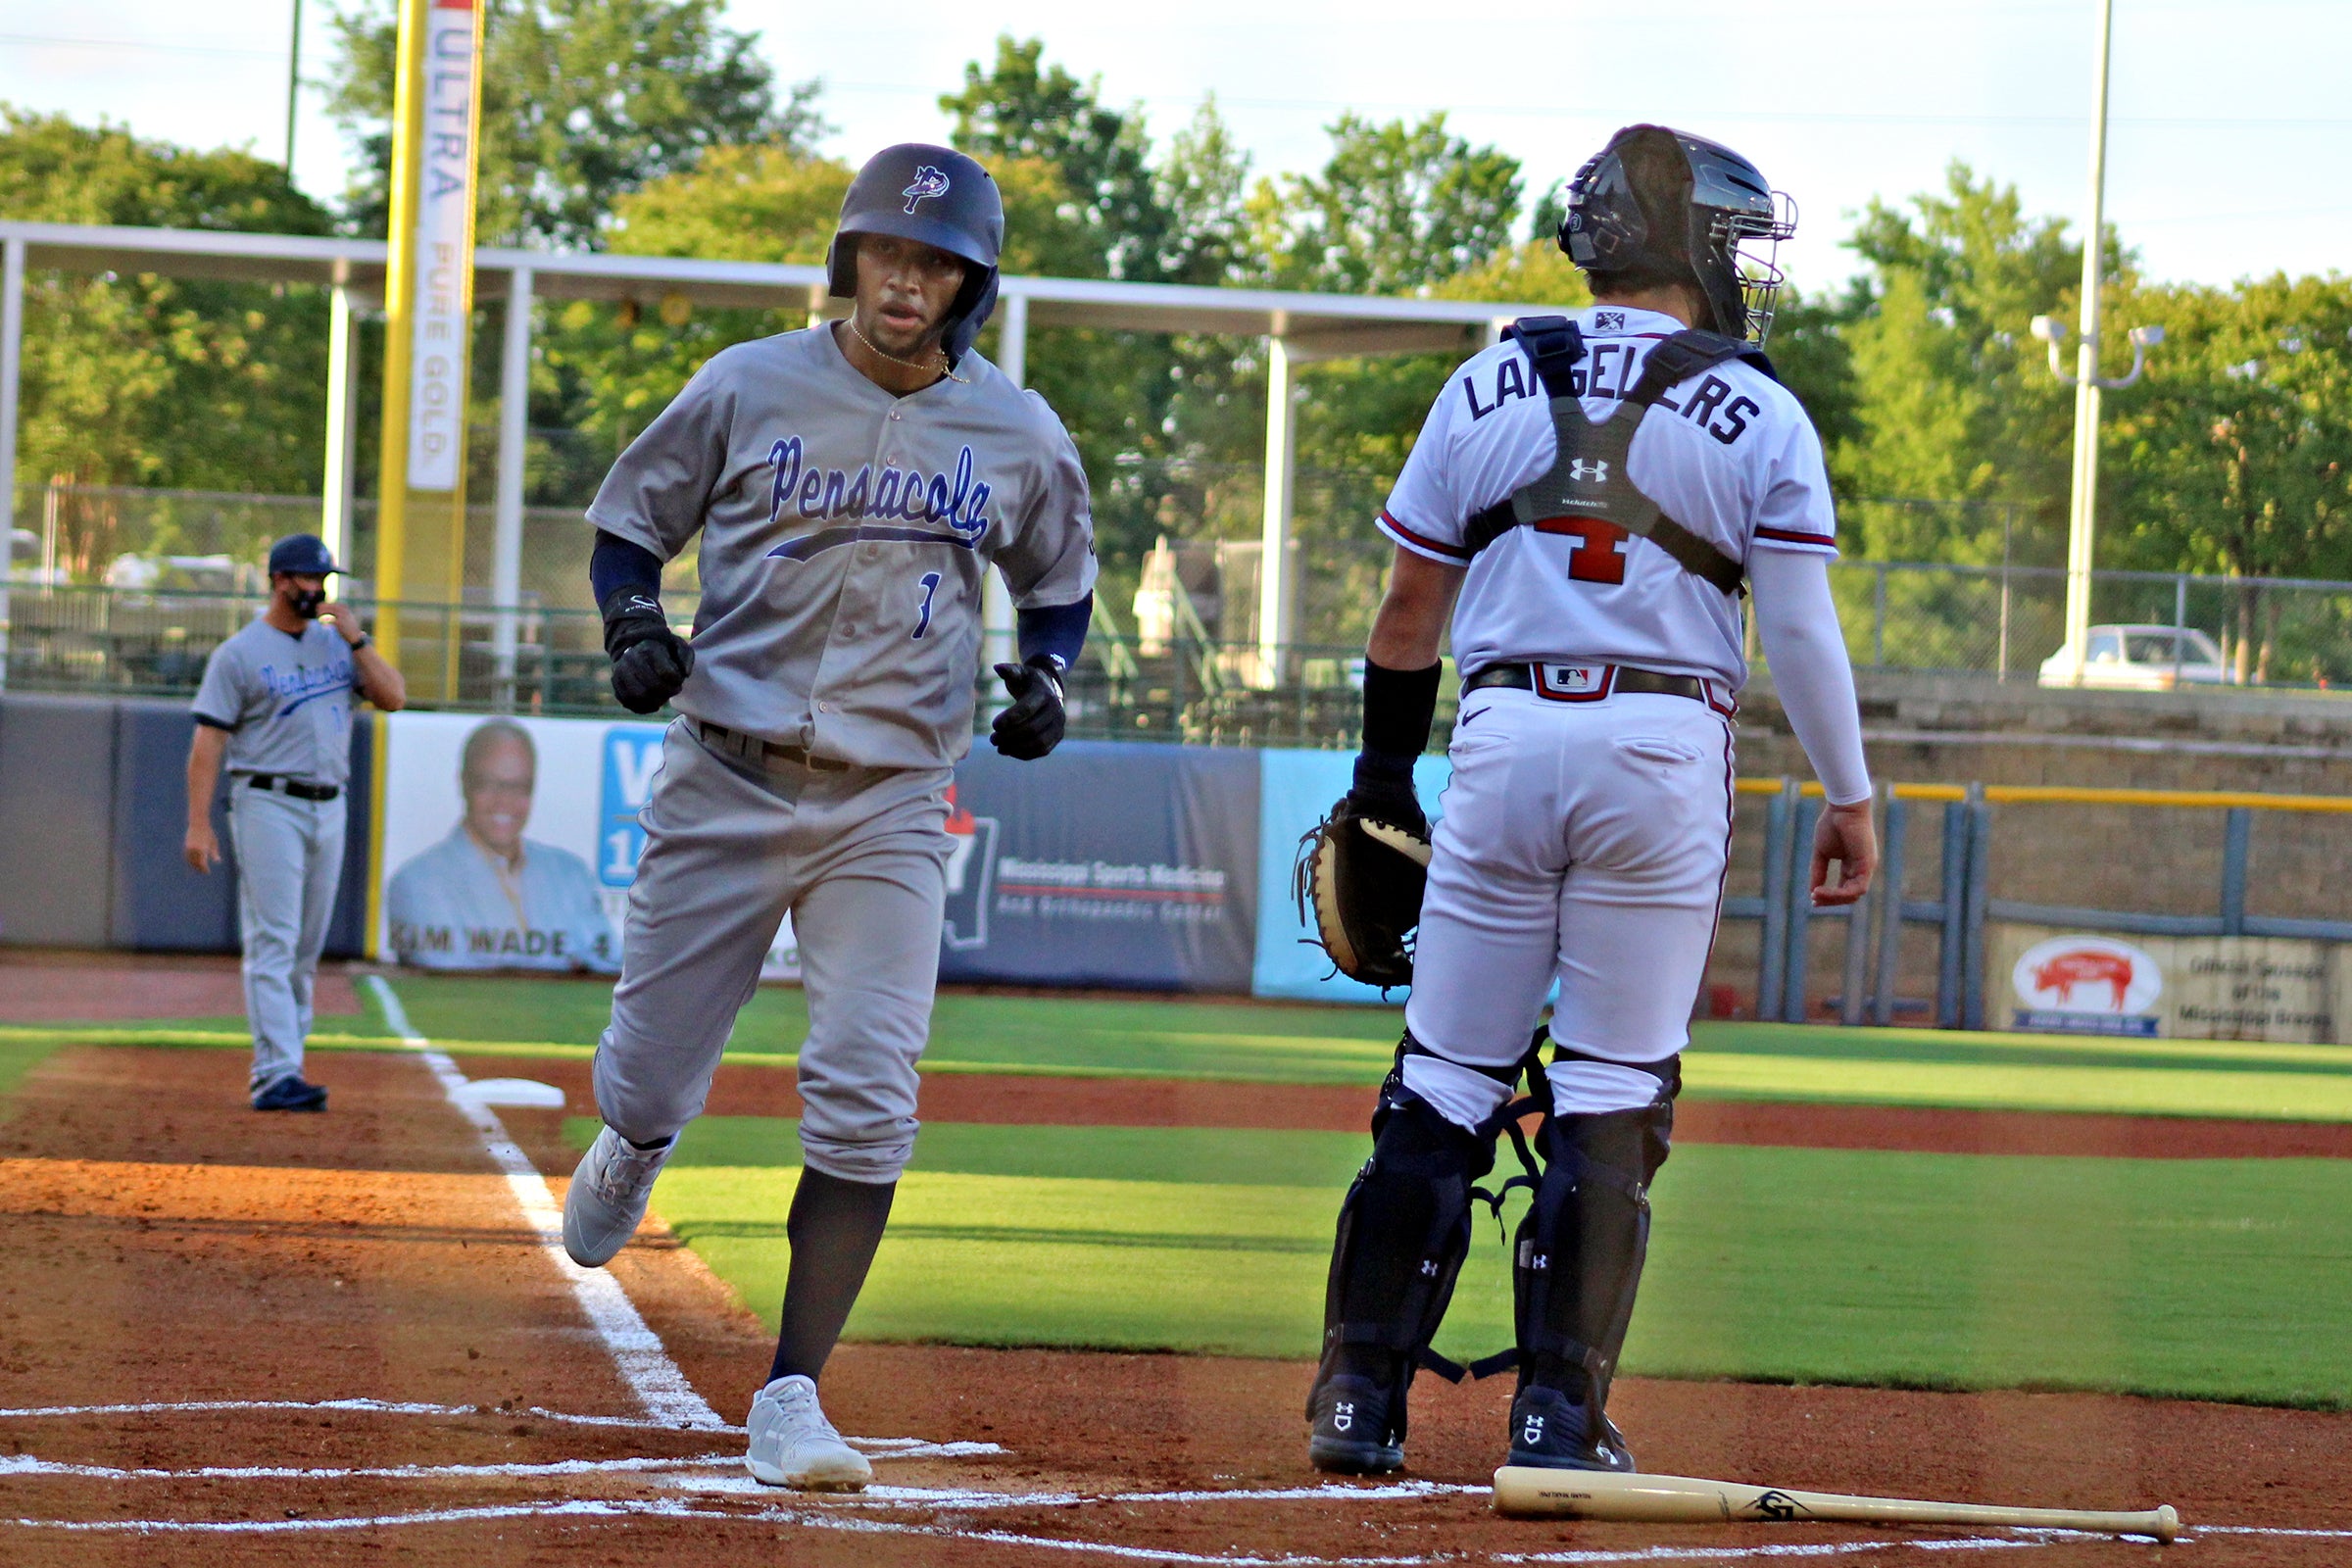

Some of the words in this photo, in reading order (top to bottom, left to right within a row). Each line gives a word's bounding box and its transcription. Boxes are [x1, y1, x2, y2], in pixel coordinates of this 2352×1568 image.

[429, 28, 472, 201] ULTRA
[425, 240, 456, 341] PURE
[1463, 343, 1760, 445] LAELRS
[766, 434, 993, 544] Pensacola
[911, 570, 942, 640] 1
